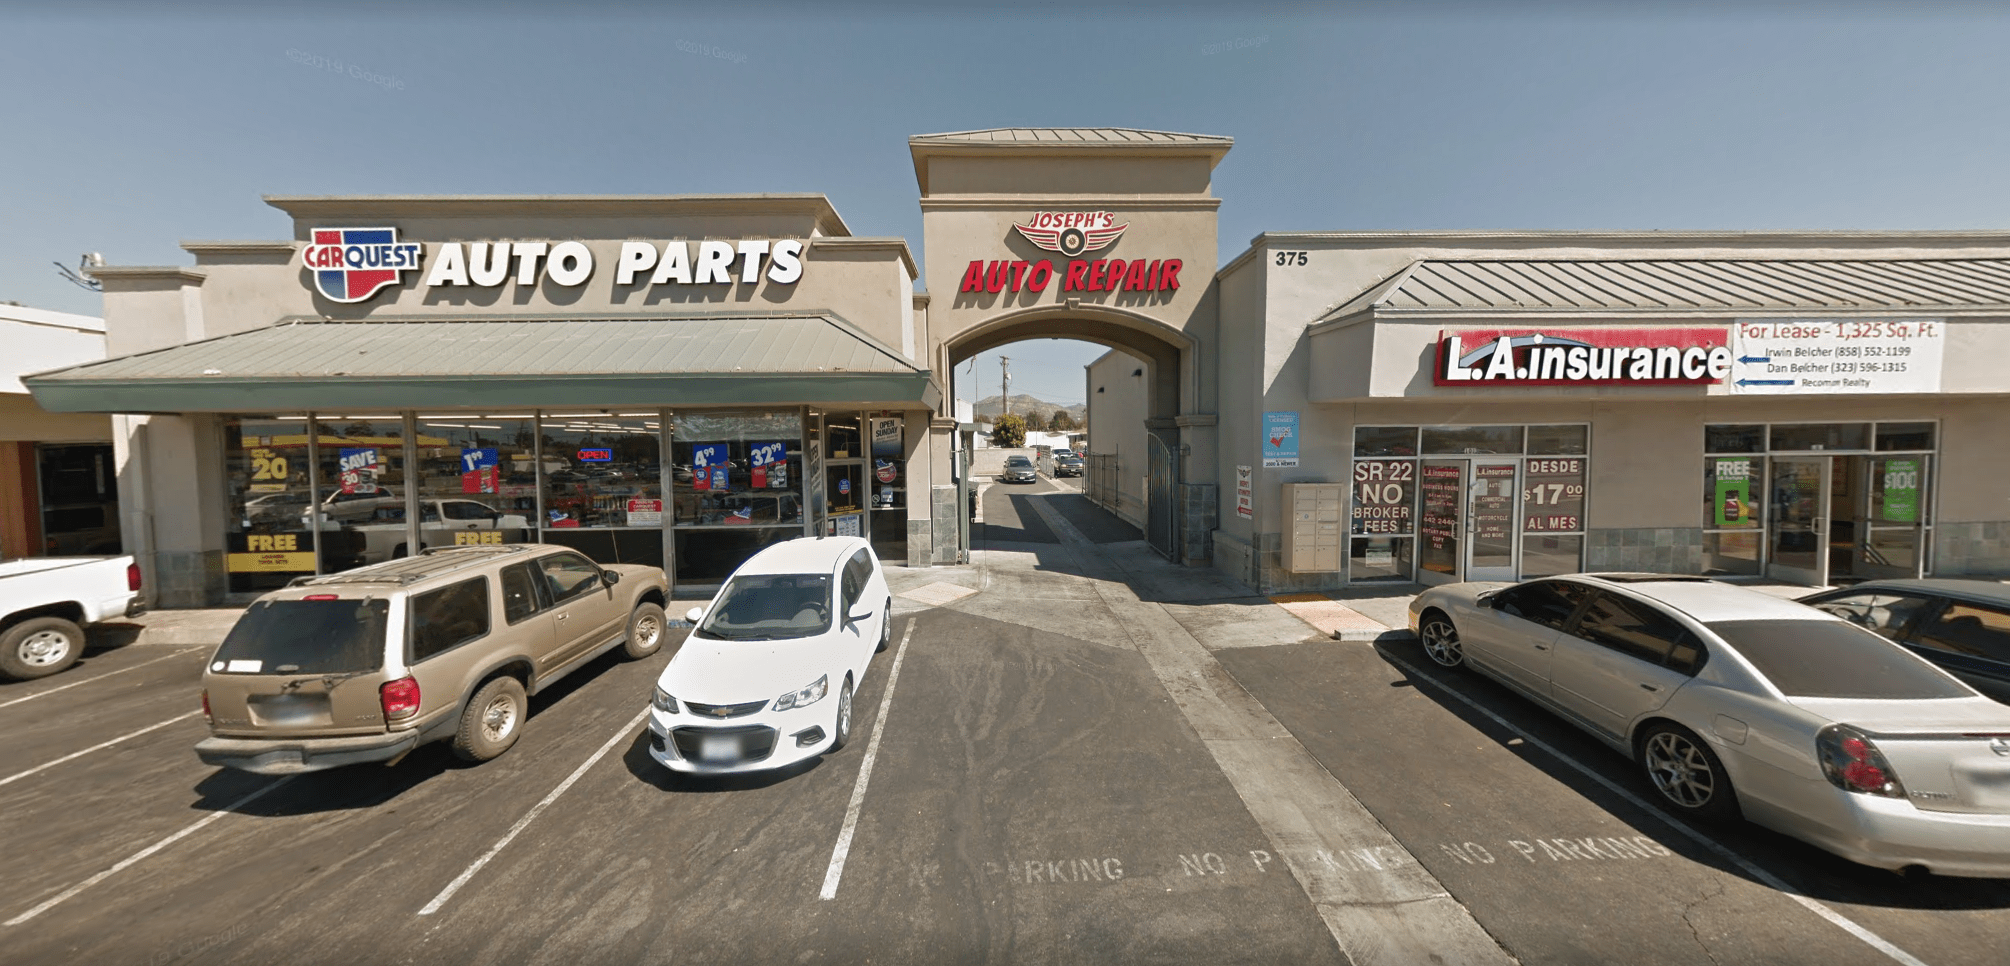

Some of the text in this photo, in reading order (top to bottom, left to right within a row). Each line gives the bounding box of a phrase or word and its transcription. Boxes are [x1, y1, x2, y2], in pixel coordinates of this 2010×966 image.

[1031, 212, 1115, 228] JOSEPH'S
[304, 238, 803, 288] CARQUEST AUTO PARTS
[1275, 251, 1308, 267] 375
[961, 258, 1184, 294] AUTO REPAIR
[1740, 322, 1767, 339] For
[1773, 322, 1821, 339] Lease
[1835, 322, 1882, 341] 1,325
[1886, 321, 1912, 341] Sq.
[1918, 322, 1938, 338] Ft.
[1765, 346, 1912, 359] Irwin Belcher (858) 552-1199
[1767, 362, 1907, 375] Dan Belcher (323) 596-1315
[875, 426, 899, 438] SUNDAY
[880, 419, 895, 429] OPEN
[340, 450, 376, 472] SAVE
[577, 450, 609, 460] OPEN
[251, 457, 287, 479] 20
[1355, 462, 1412, 481] SR 22
[1530, 460, 1578, 473] DESDE
[1716, 461, 1750, 476] FREE
[1362, 483, 1403, 504] NO
[1354, 507, 1409, 518] BROKER
[1364, 520, 1398, 532] FEES
[1527, 516, 1577, 529] AL MES
[248, 535, 297, 551] FREE
[455, 531, 502, 546] FREE
[1440, 837, 1671, 865] NO PARKING
[1178, 851, 1227, 878] NO
